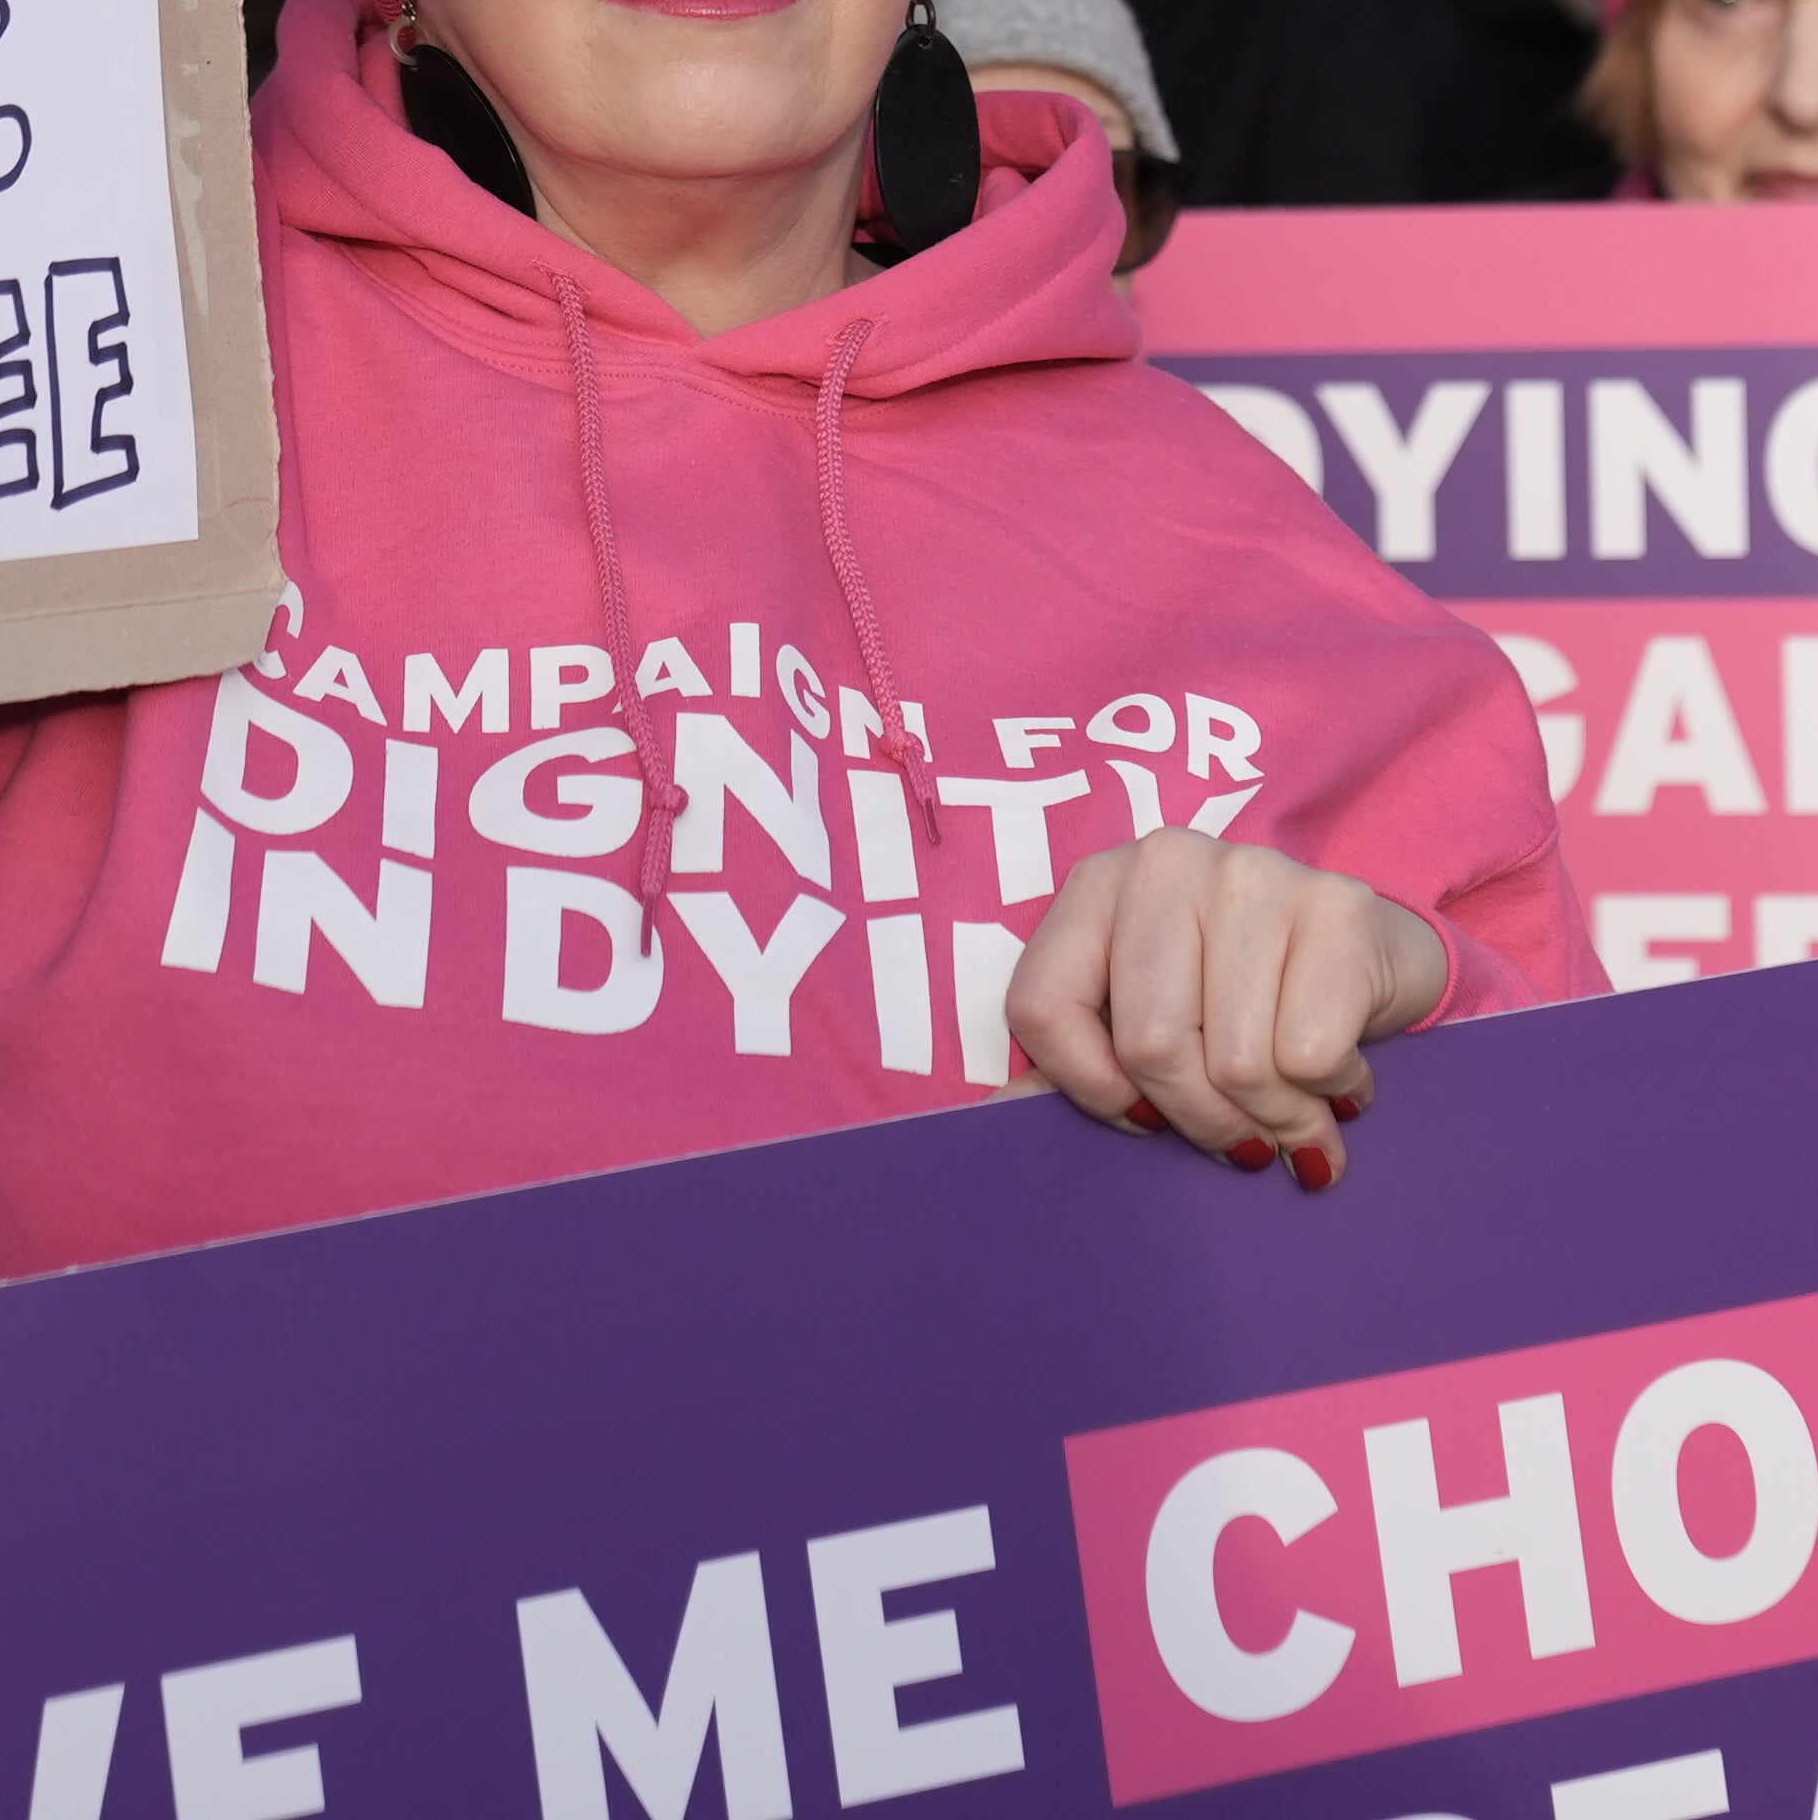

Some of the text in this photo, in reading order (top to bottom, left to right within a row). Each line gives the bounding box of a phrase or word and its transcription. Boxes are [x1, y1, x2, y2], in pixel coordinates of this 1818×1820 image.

[992, 691, 1266, 782] FOR
[159, 805, 435, 1010] IN
[514, 1502, 1028, 1820] ME
